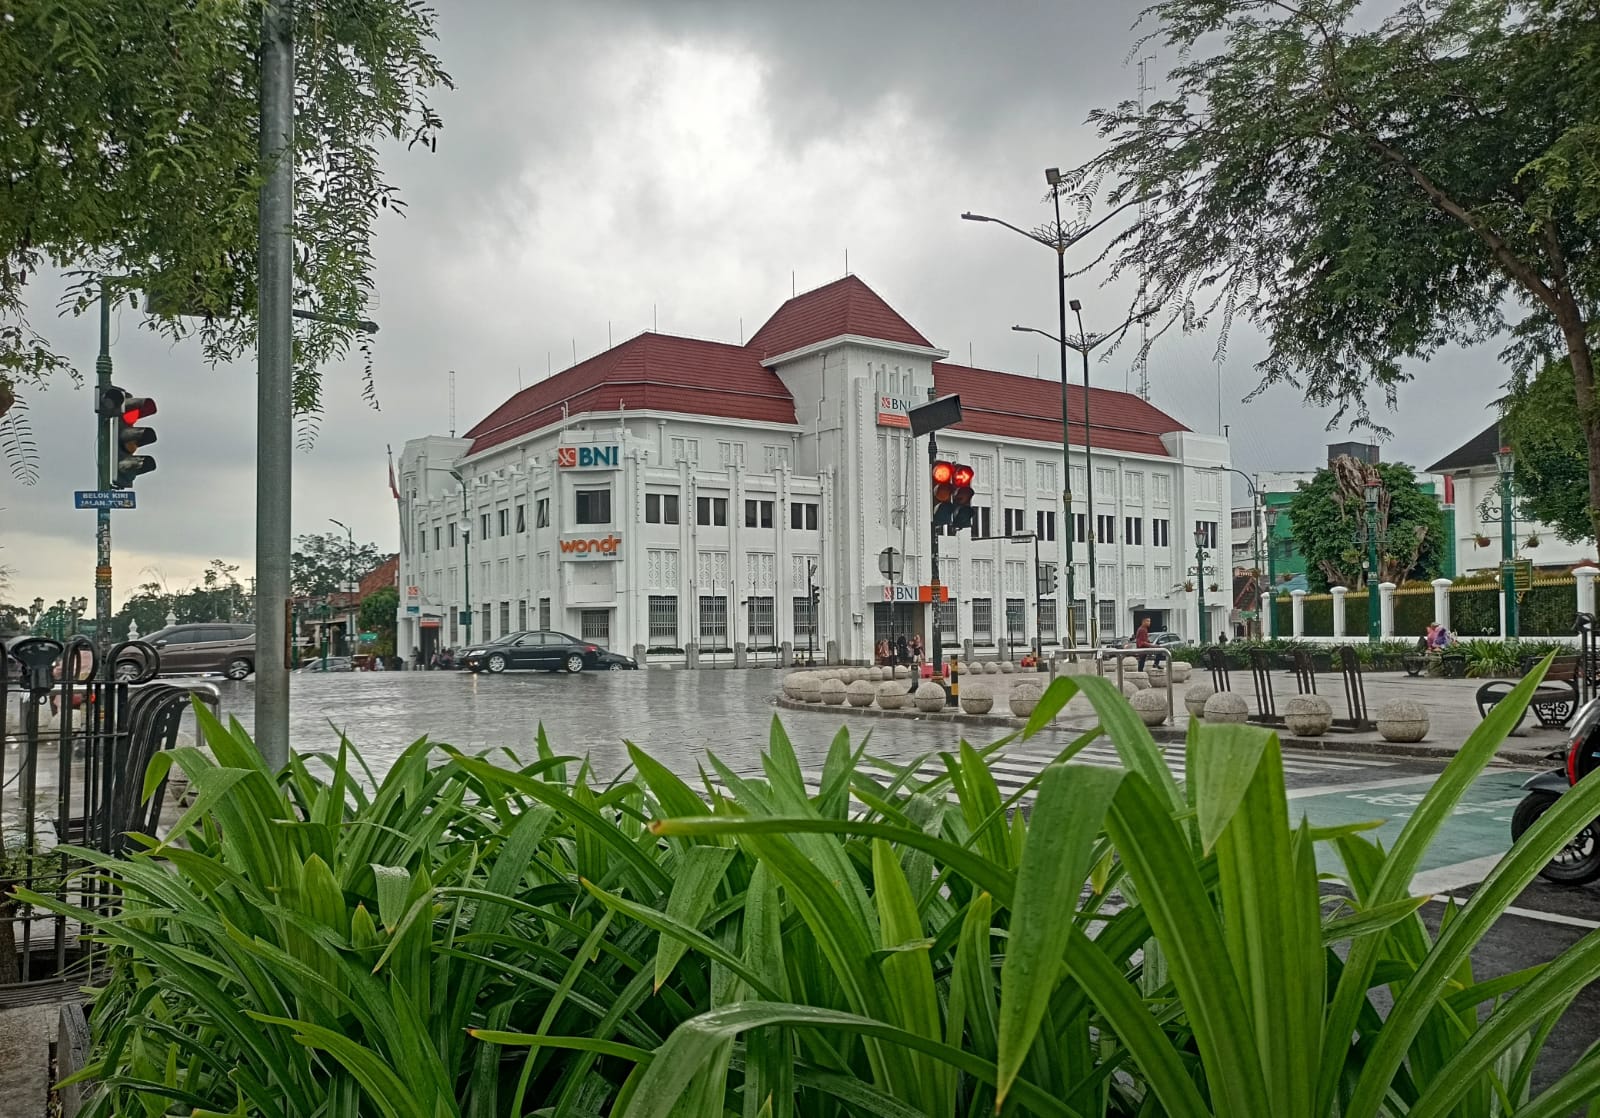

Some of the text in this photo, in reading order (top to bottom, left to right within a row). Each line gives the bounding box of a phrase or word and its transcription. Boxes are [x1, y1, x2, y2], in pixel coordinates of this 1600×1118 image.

[892, 398, 911, 411] BNI
[578, 446, 619, 466] BNI
[559, 534, 622, 553] wondr
[896, 586, 918, 600] BNI
